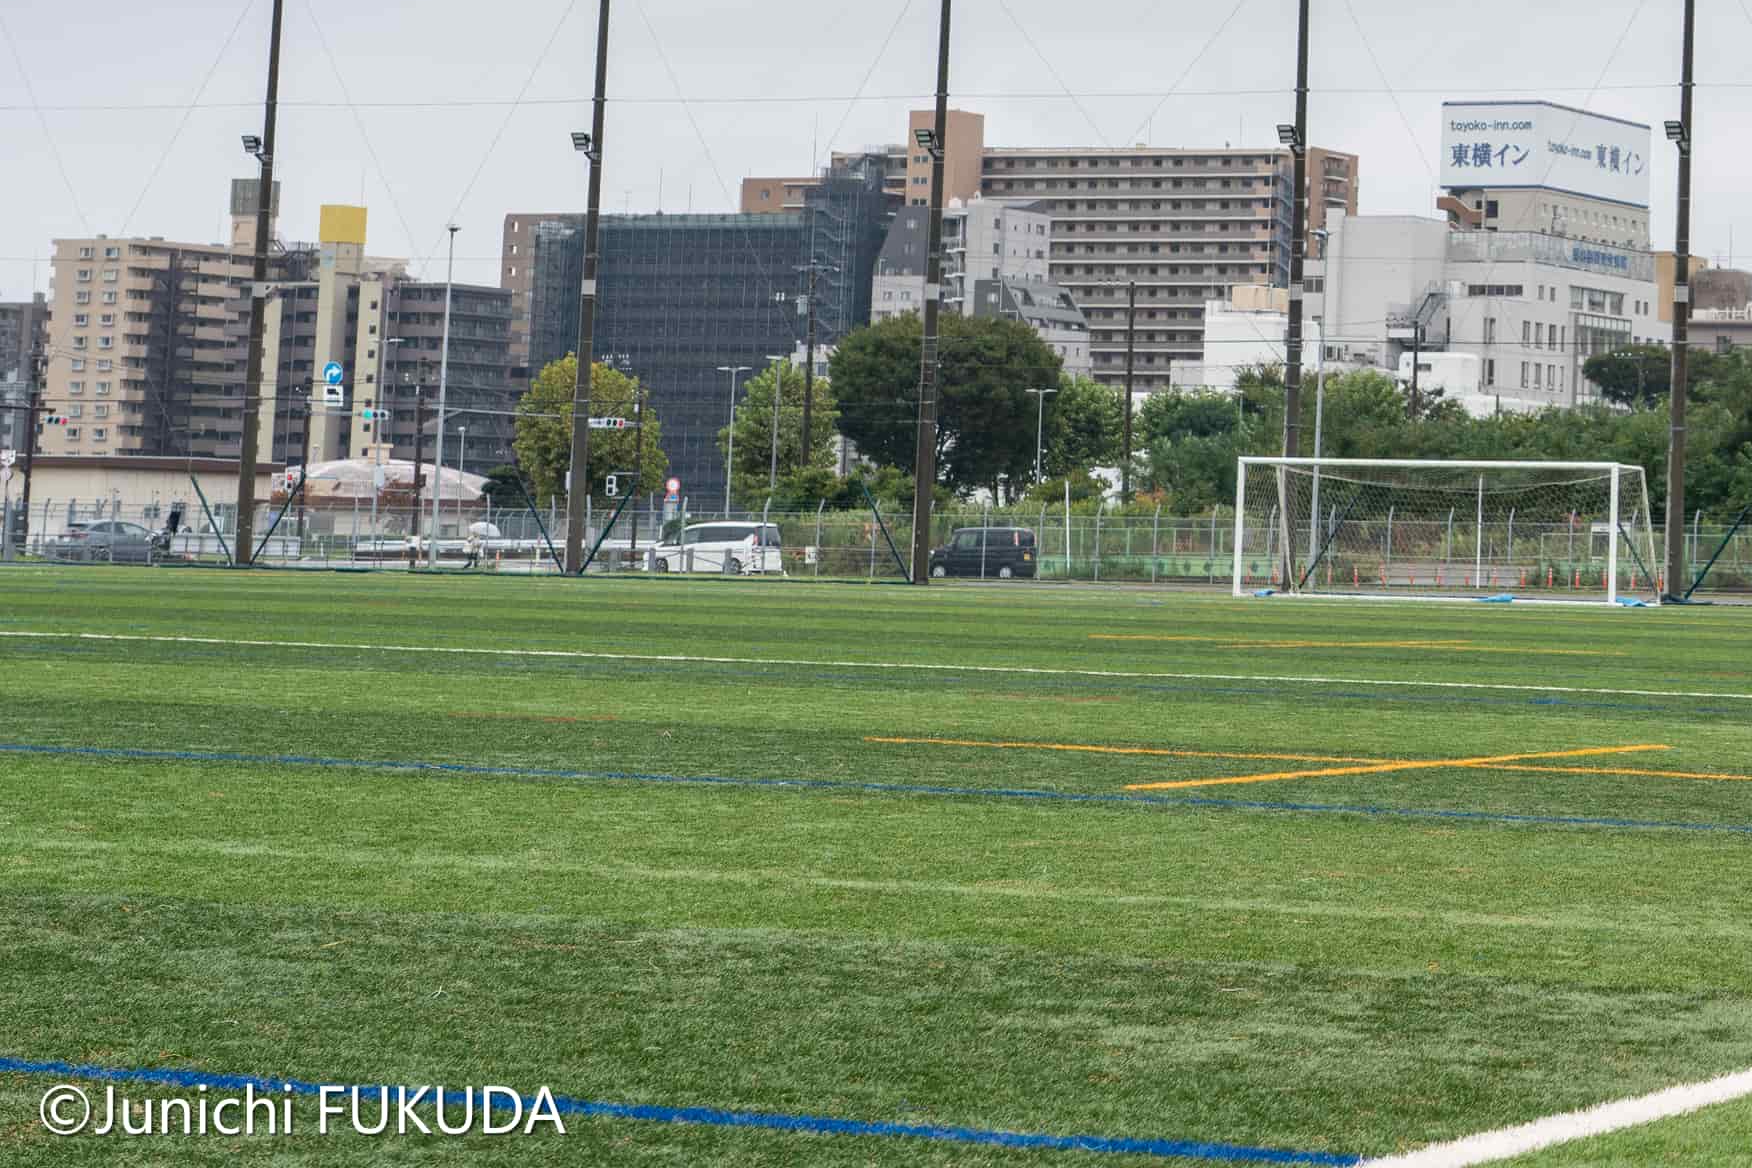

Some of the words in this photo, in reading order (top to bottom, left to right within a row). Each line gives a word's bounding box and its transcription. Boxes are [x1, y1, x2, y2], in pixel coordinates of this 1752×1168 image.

[1451, 119, 1532, 131] toyoko-inn.com
[1450, 143, 1529, 167] 東横イン
[1596, 144, 1645, 175] 東横イン
